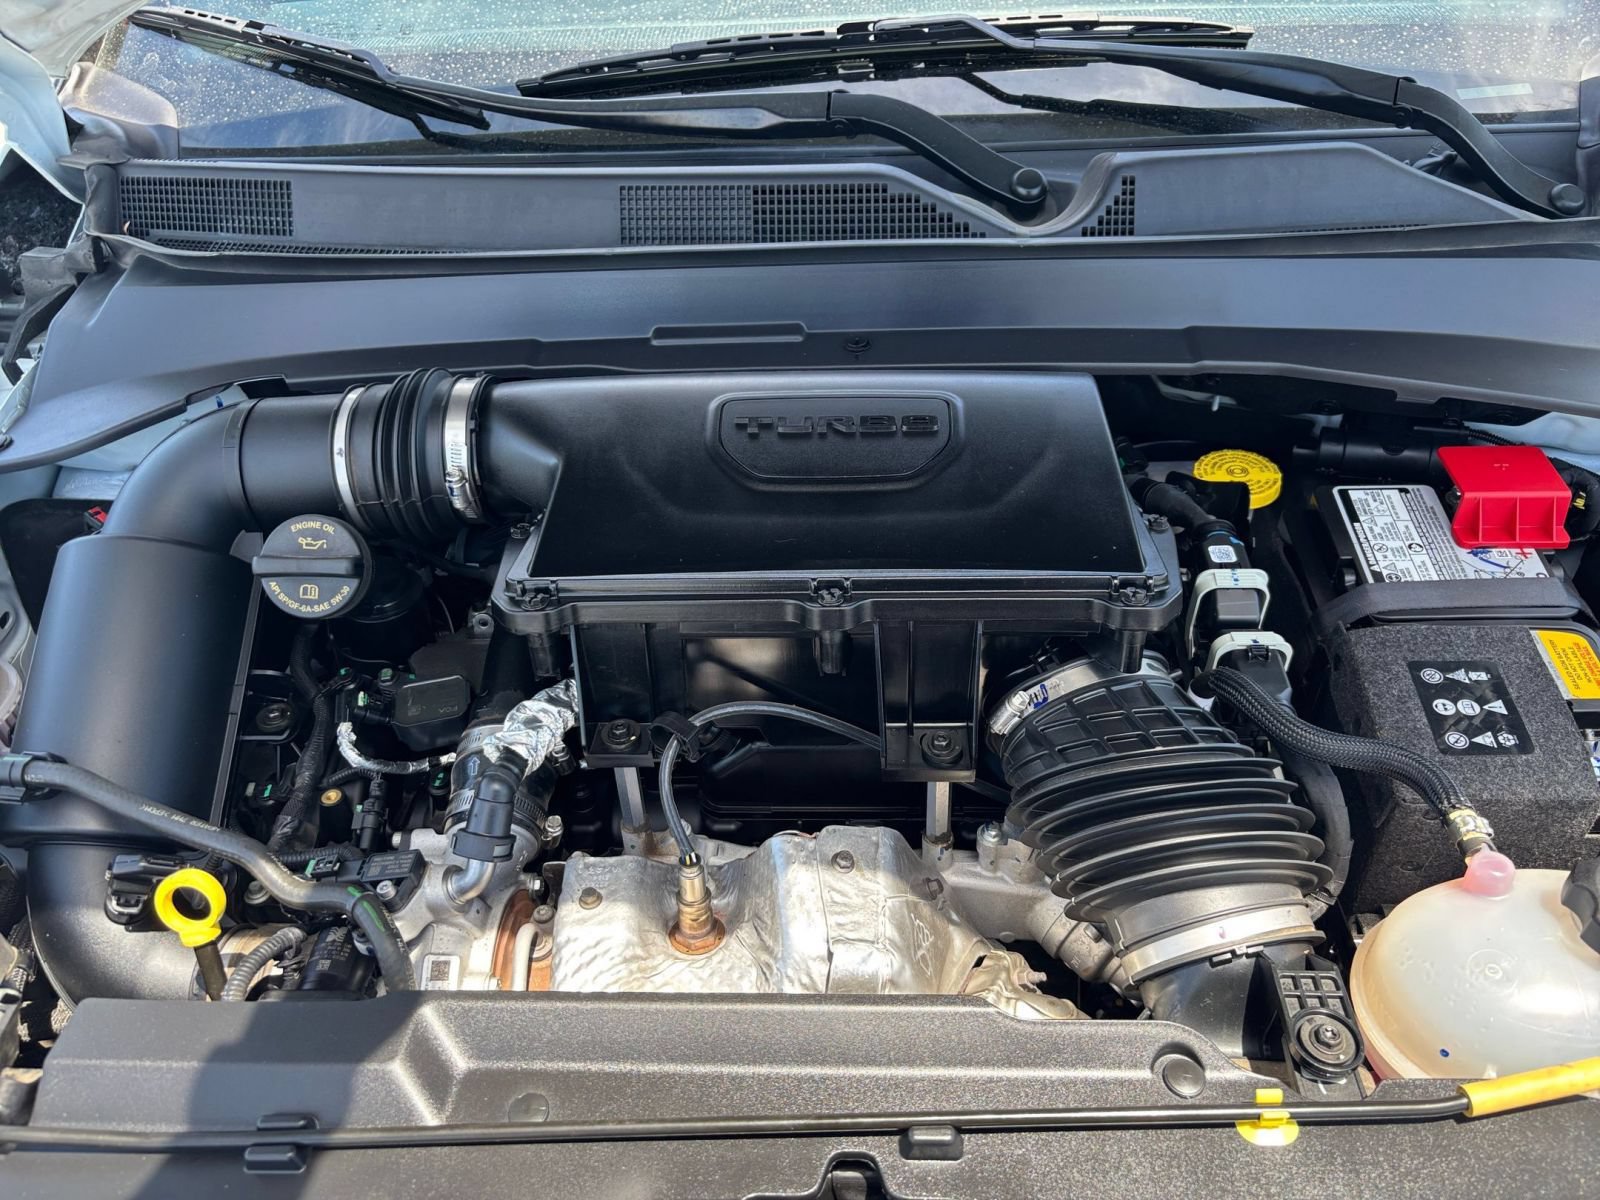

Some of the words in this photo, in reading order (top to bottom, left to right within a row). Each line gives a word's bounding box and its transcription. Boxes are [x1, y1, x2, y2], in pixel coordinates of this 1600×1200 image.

[735, 415, 939, 434] TURBO
[290, 521, 322, 533] ENGINE
[322, 522, 336, 535] OIL
[269, 581, 281, 595] API
[330, 585, 350, 606] 5W-30
